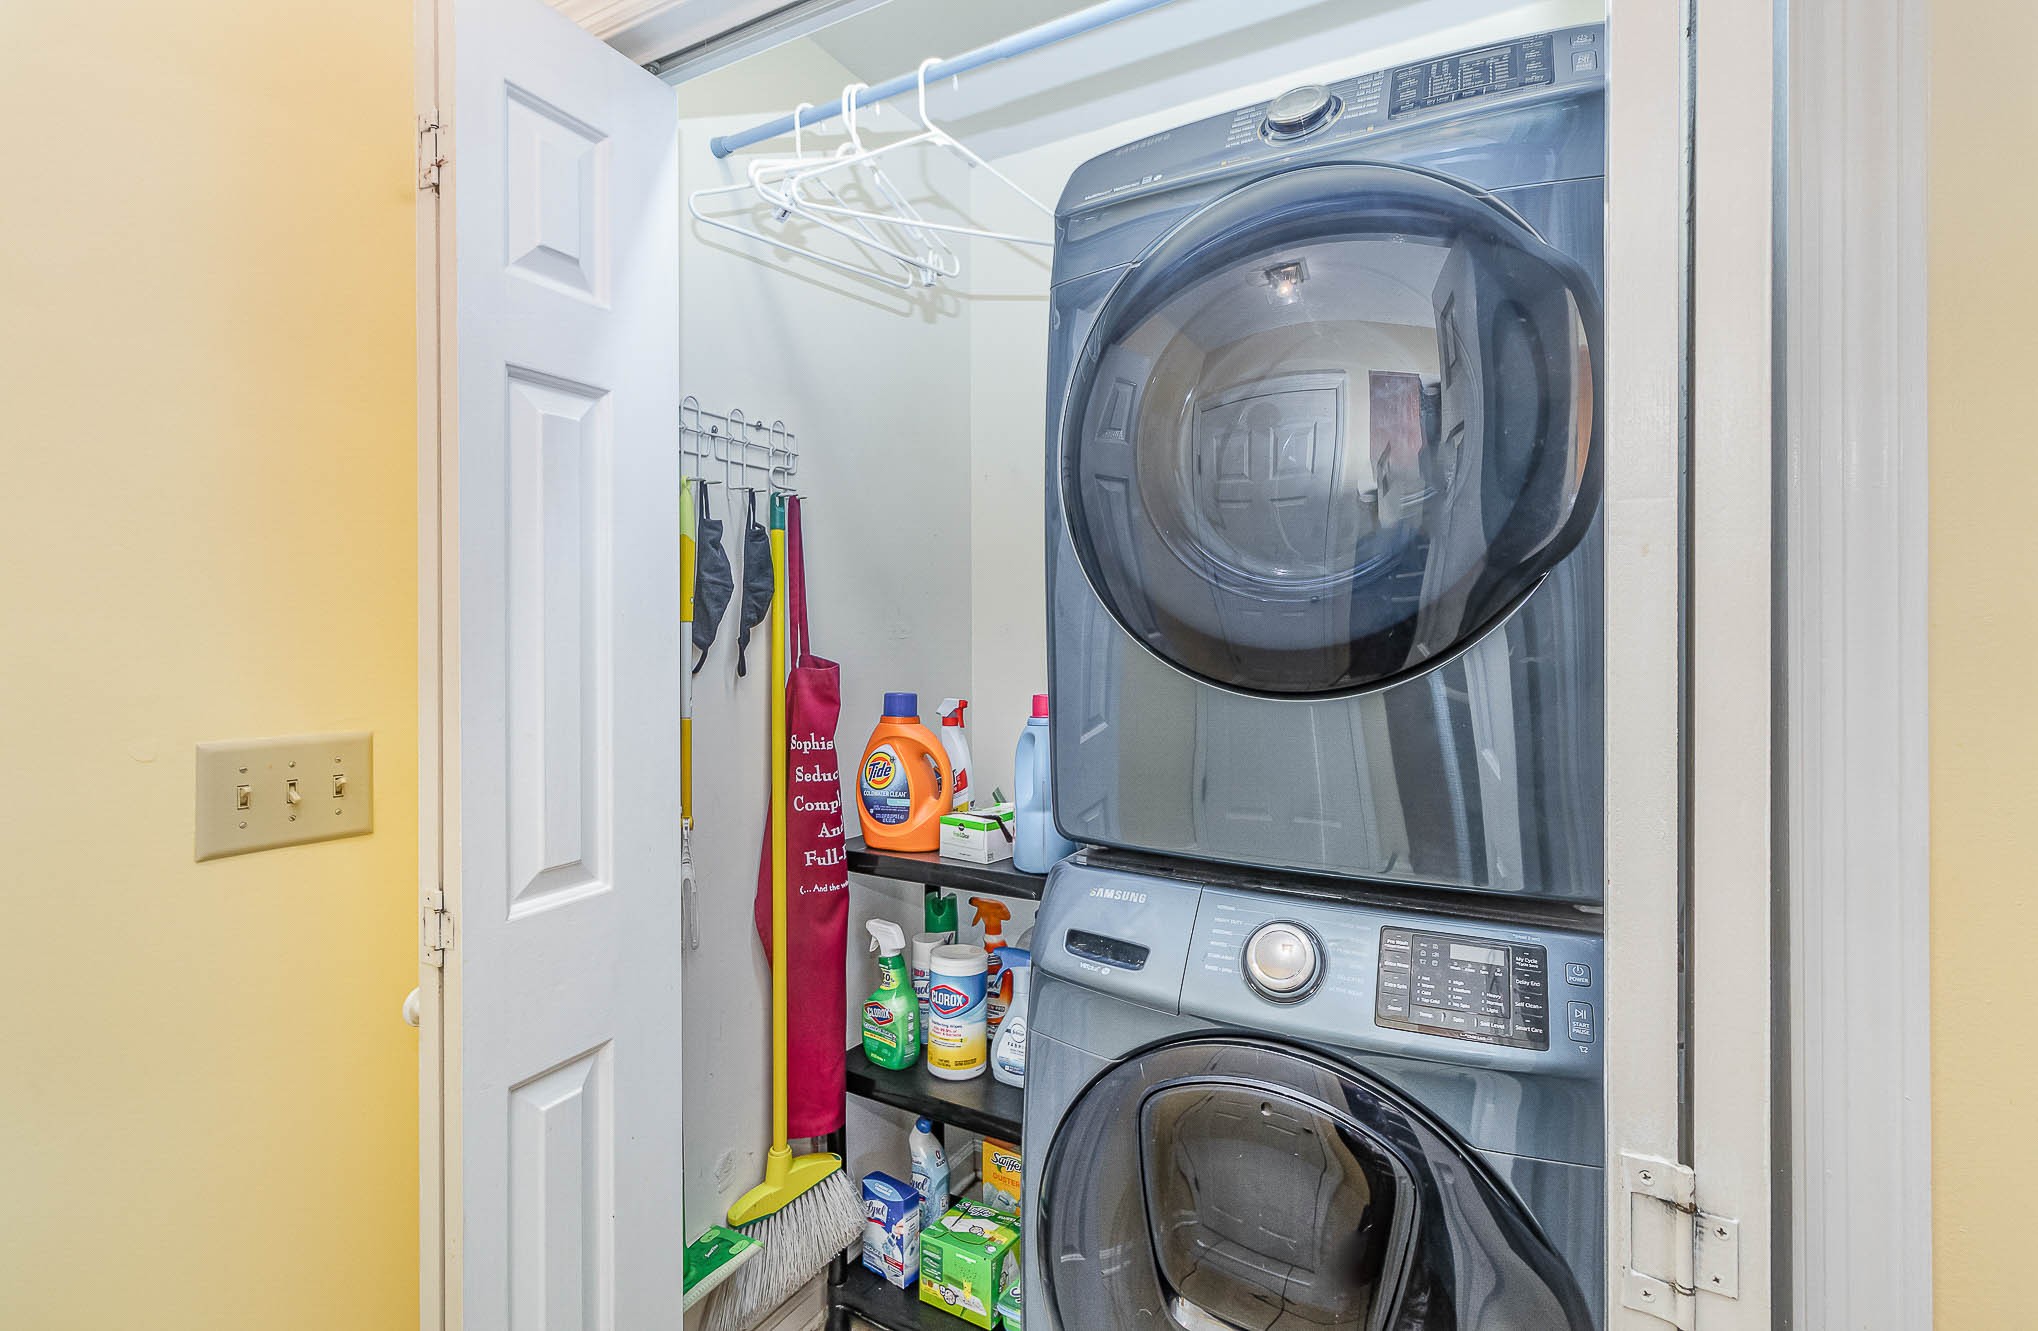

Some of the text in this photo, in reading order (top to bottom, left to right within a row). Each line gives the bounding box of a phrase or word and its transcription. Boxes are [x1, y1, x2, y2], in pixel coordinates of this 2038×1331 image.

[790, 733, 834, 754] Sophis
[869, 761, 891, 782] Tide
[1089, 887, 1147, 904] SAMSUNG
[1515, 956, 1538, 965] My Cycle
[1515, 979, 1530, 987] Delay
[931, 990, 963, 1007] CLOROX
[866, 1006, 891, 1019] CLOROX
[1490, 1022, 1505, 1030] Level
[1572, 1021, 1590, 1029] START
[1531, 1026, 1543, 1034] Care
[1572, 1028, 1591, 1036] PAUSE
